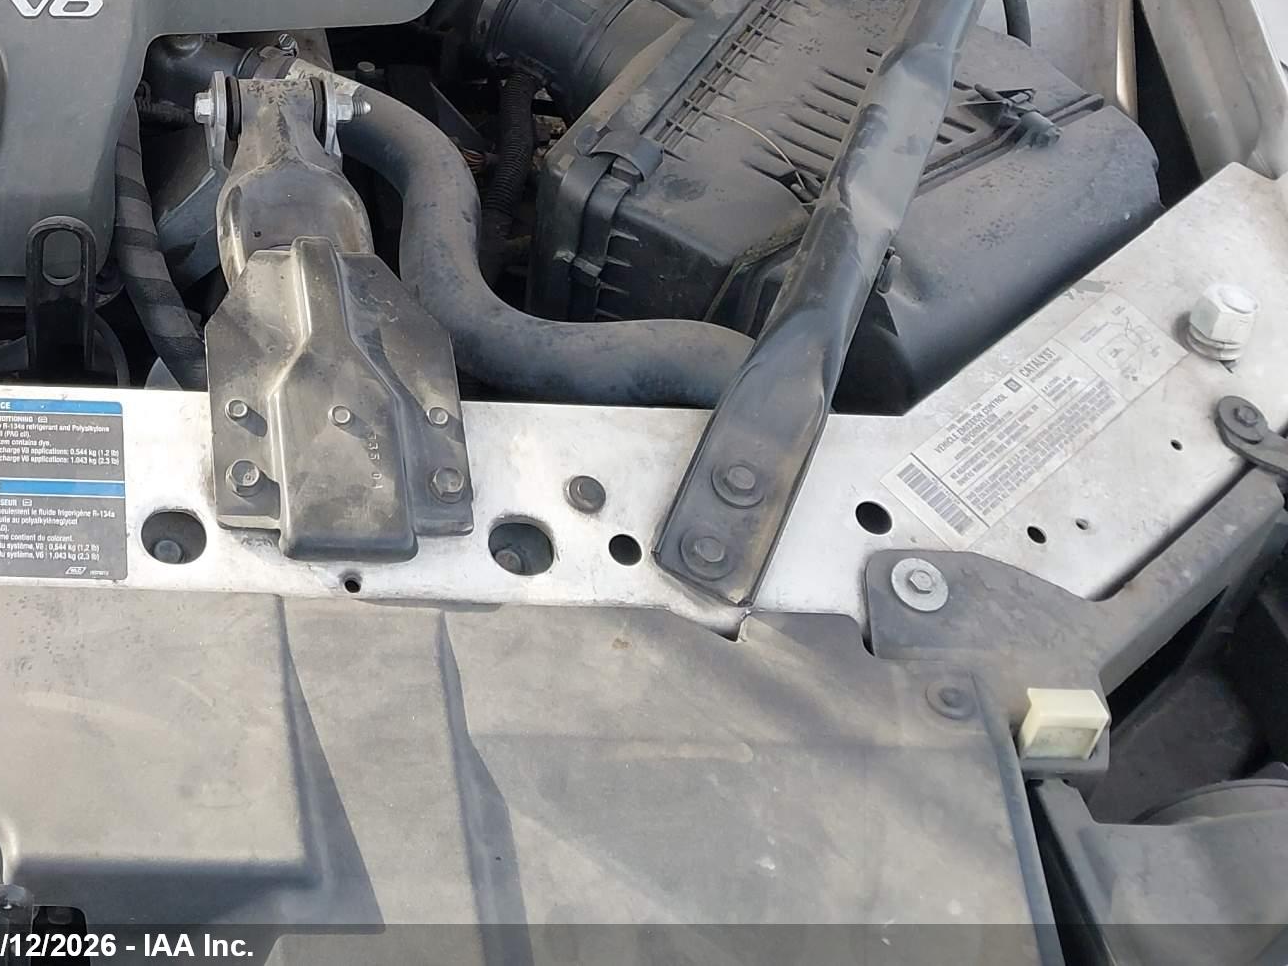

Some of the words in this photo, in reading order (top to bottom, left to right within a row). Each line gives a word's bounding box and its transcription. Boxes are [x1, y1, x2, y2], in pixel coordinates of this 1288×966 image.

[1018, 347, 1056, 378] CATALYST
[934, 433, 959, 454] VEHICLE
[982, 394, 1008, 415] CONTROL
